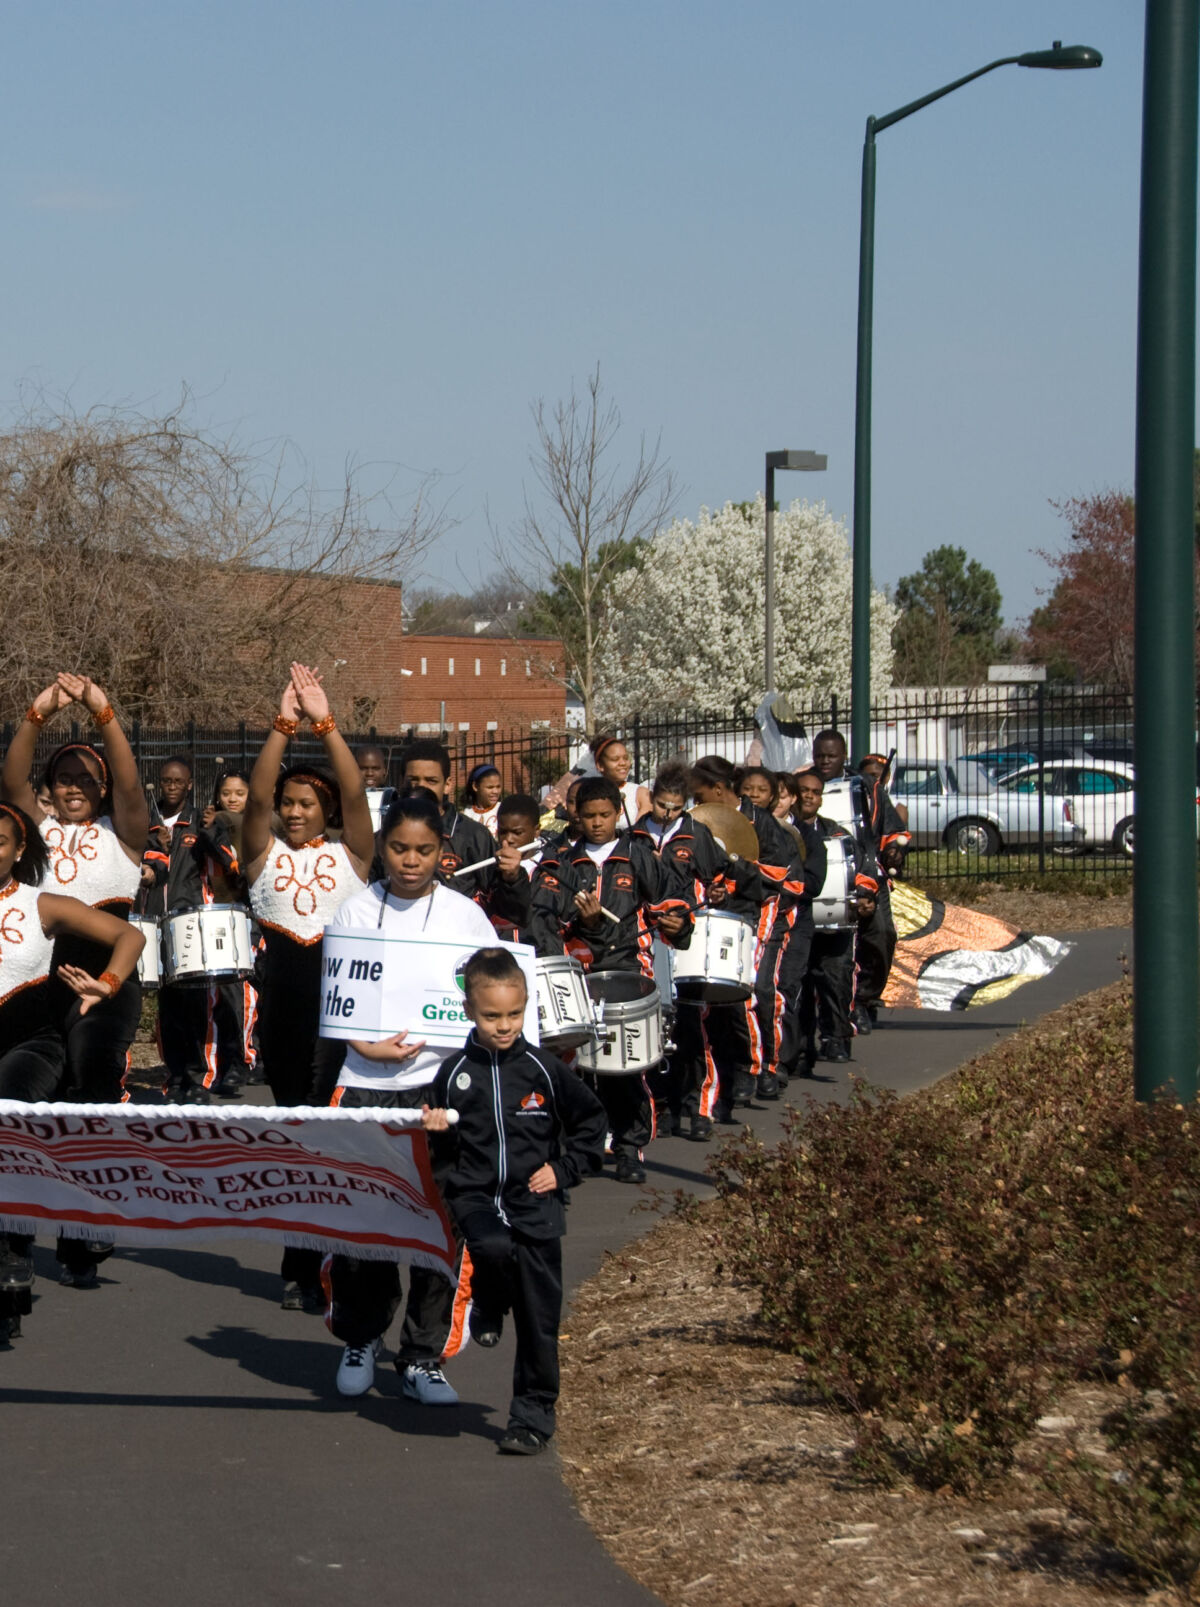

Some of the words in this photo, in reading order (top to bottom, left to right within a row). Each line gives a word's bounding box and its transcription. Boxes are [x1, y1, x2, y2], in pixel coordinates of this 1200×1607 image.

[348, 958, 383, 982] me
[324, 985, 355, 1018] the
[422, 1004, 468, 1022] Gree
[552, 980, 576, 1022] Pearl
[625, 1023, 640, 1061] Pearl
[134, 1186, 218, 1207] NORTH
[224, 1190, 353, 1213] CAROLINA
[162, 1170, 205, 1189] OF
[215, 1168, 430, 1219] EXCELLENCE
